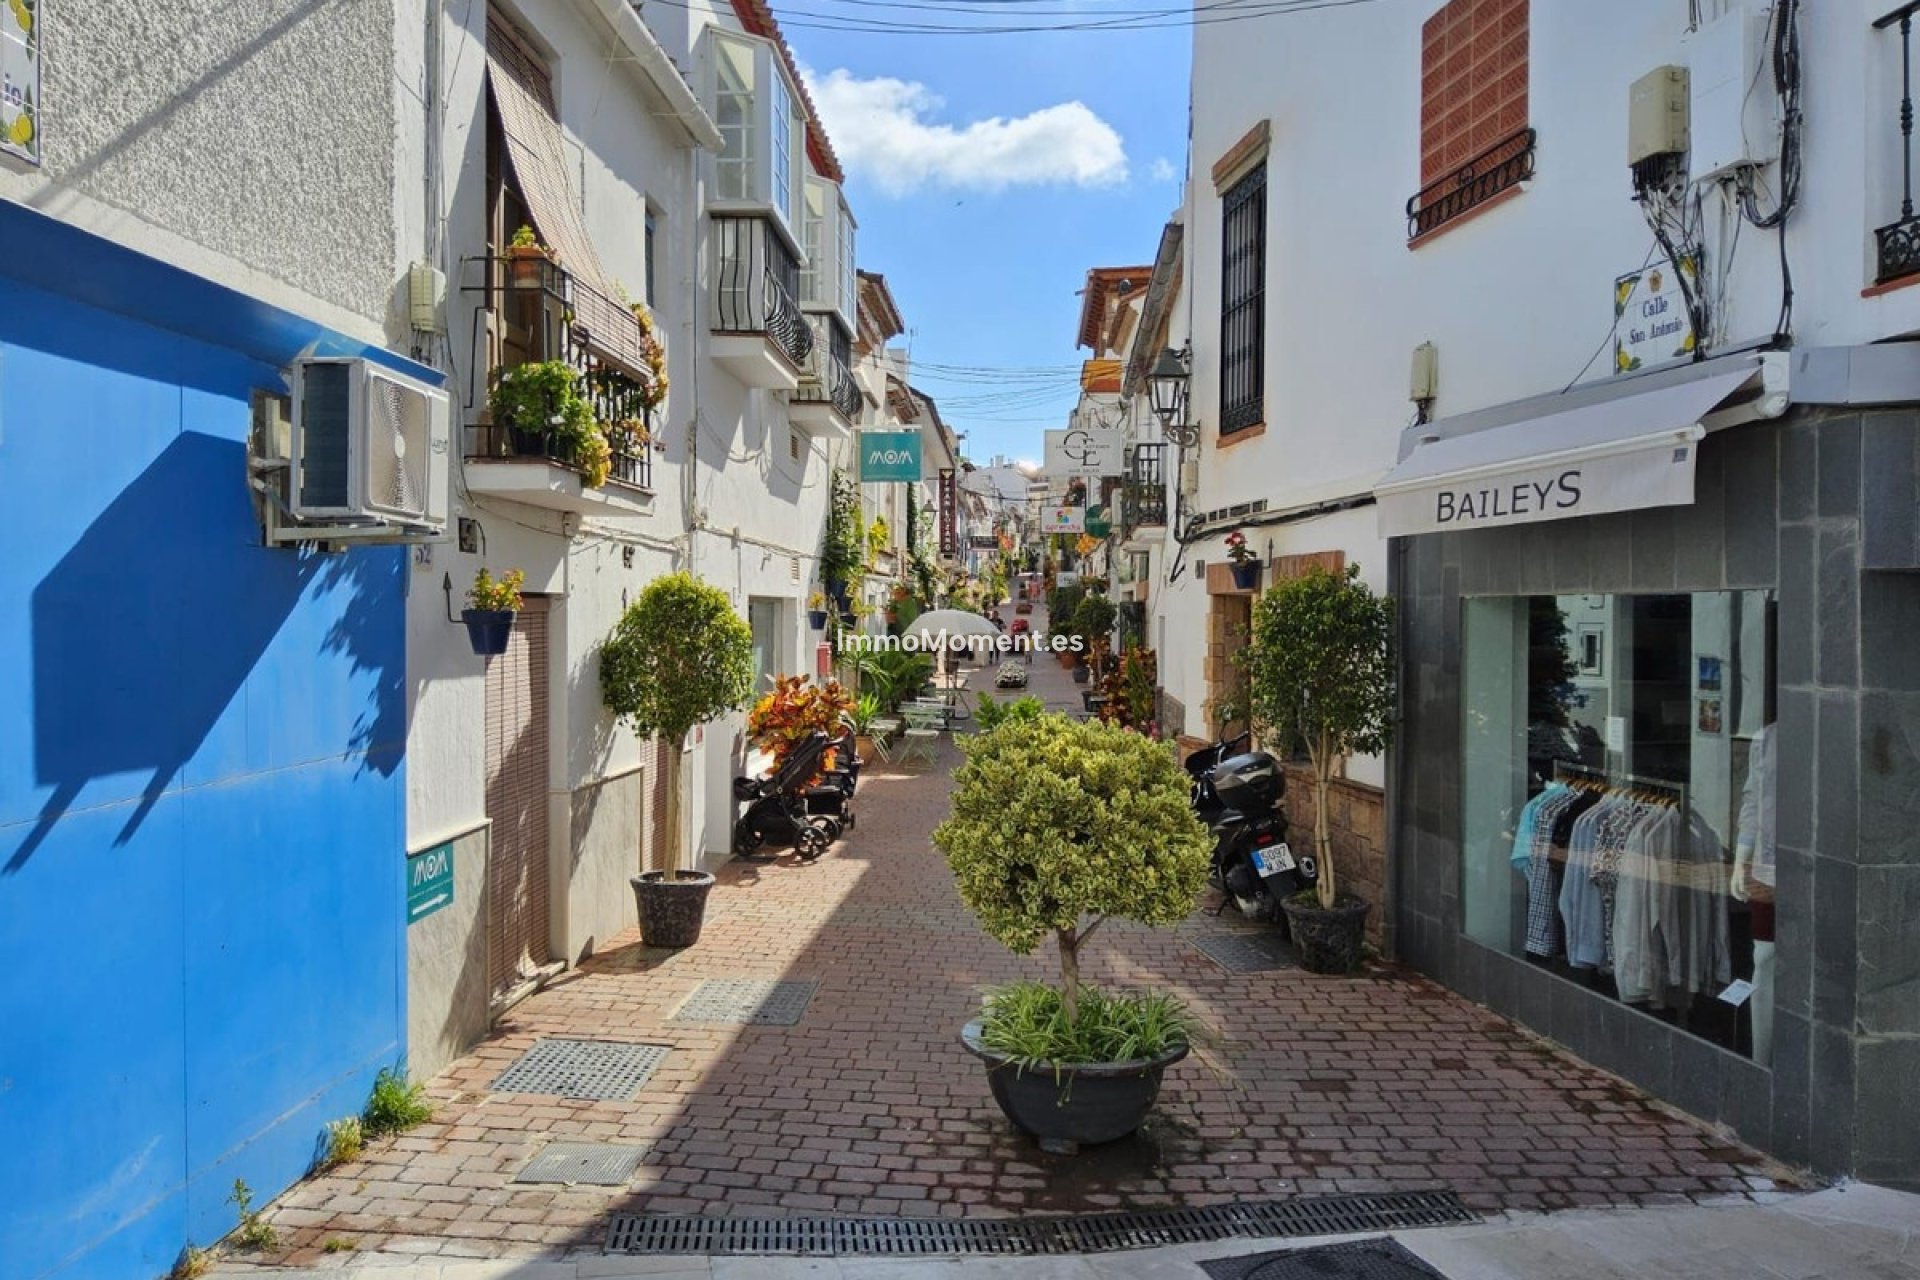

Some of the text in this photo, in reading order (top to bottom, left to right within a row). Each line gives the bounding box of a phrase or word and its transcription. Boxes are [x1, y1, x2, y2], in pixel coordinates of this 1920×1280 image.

[1643, 295, 1668, 318] Calle
[868, 449, 913, 465] MOM
[1436, 470, 1582, 523] BAILEYS
[413, 850, 449, 887] MOM
